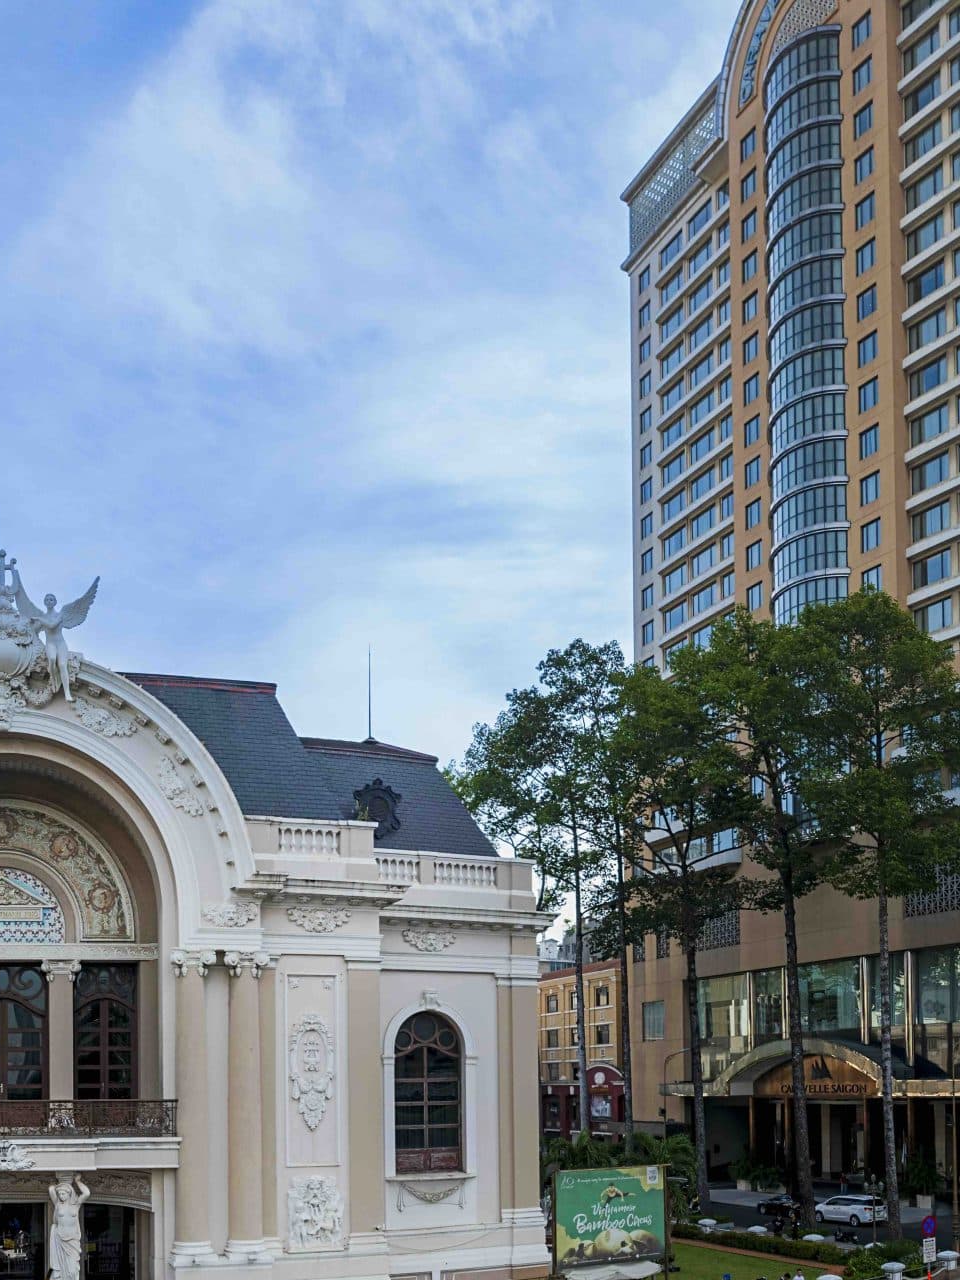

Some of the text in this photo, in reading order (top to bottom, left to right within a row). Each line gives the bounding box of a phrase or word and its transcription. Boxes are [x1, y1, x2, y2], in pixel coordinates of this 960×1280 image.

[831, 1084, 867, 1093] SAIGON
[591, 1203, 636, 1217] Vietnamese
[573, 1213, 653, 1234] Bamboo Circus
